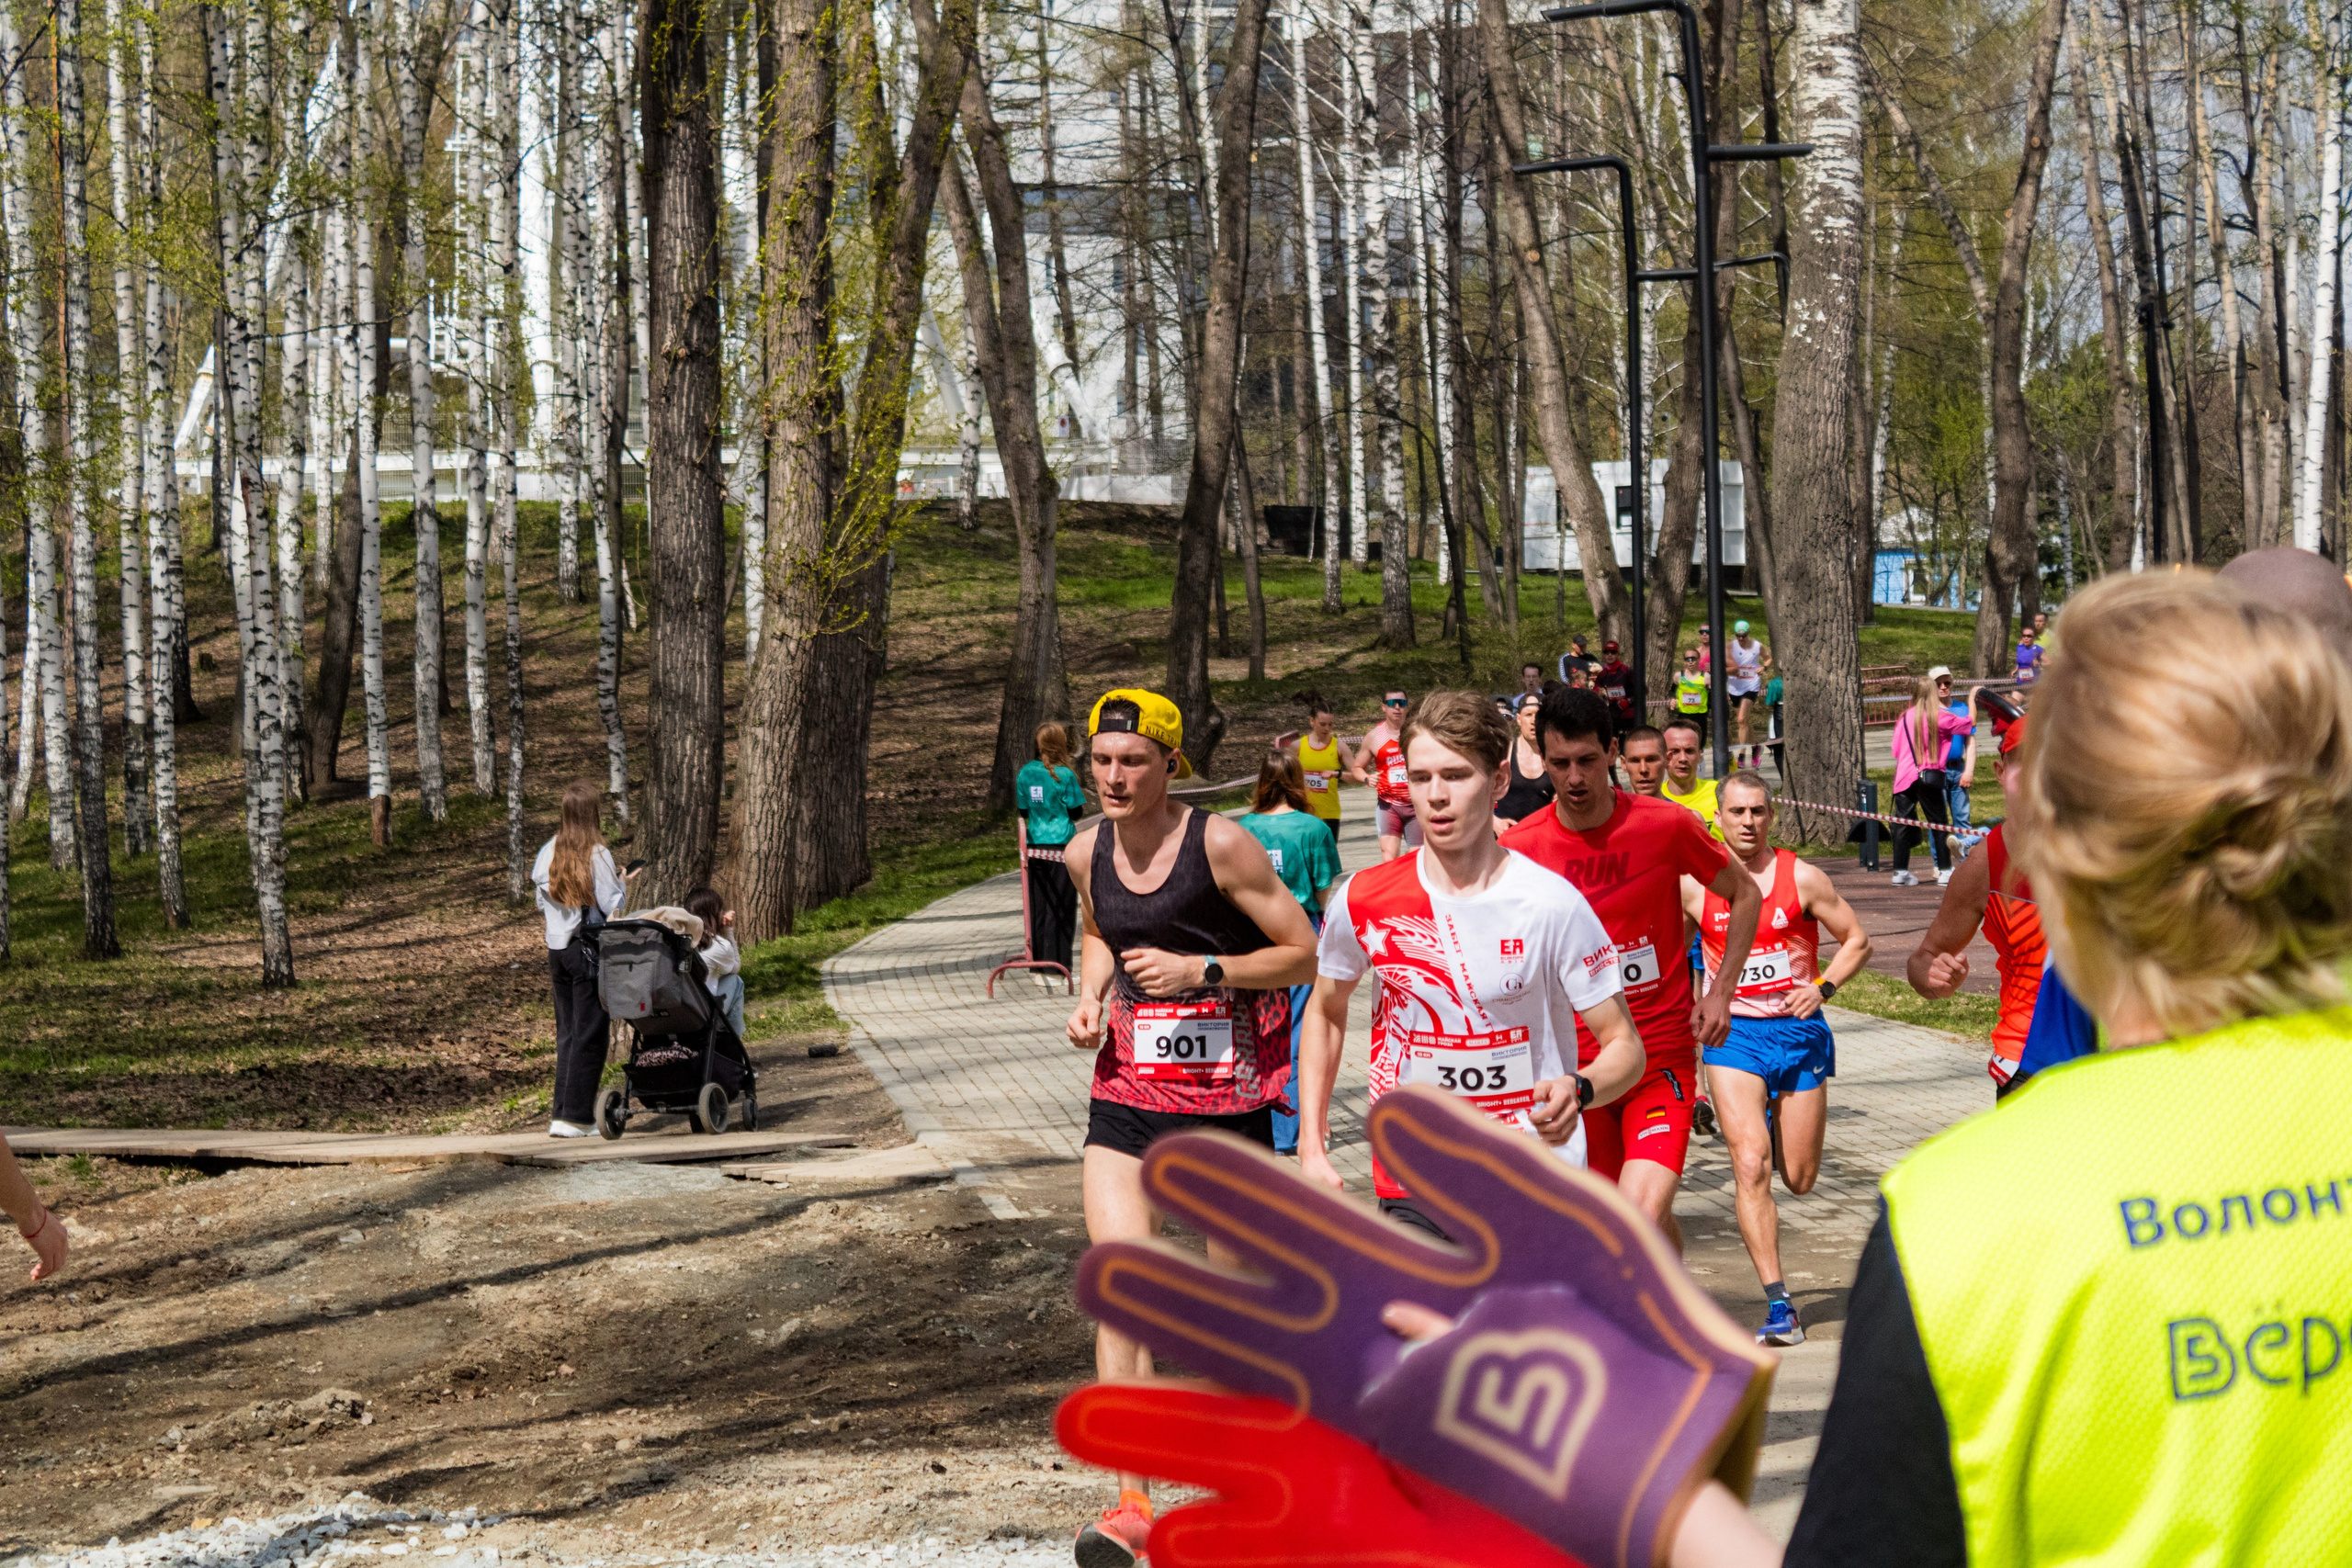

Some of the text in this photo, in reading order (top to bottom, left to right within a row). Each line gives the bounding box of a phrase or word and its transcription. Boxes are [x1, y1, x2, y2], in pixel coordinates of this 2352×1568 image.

[1145, 725, 1166, 740] NIKE
[1564, 852, 1631, 889] RUN
[1445, 914, 1463, 957] ЗАБЕГ
[1460, 963, 1487, 1020] МАЙСКАЯ
[1156, 1035, 1206, 1059] 901
[1491, 1046, 1527, 1057] ВИКТОРИЯ
[1438, 1065, 1507, 1091] 303
[2120, 1179, 2352, 1247] Волон
[2167, 1302, 2352, 1400] Вёр
